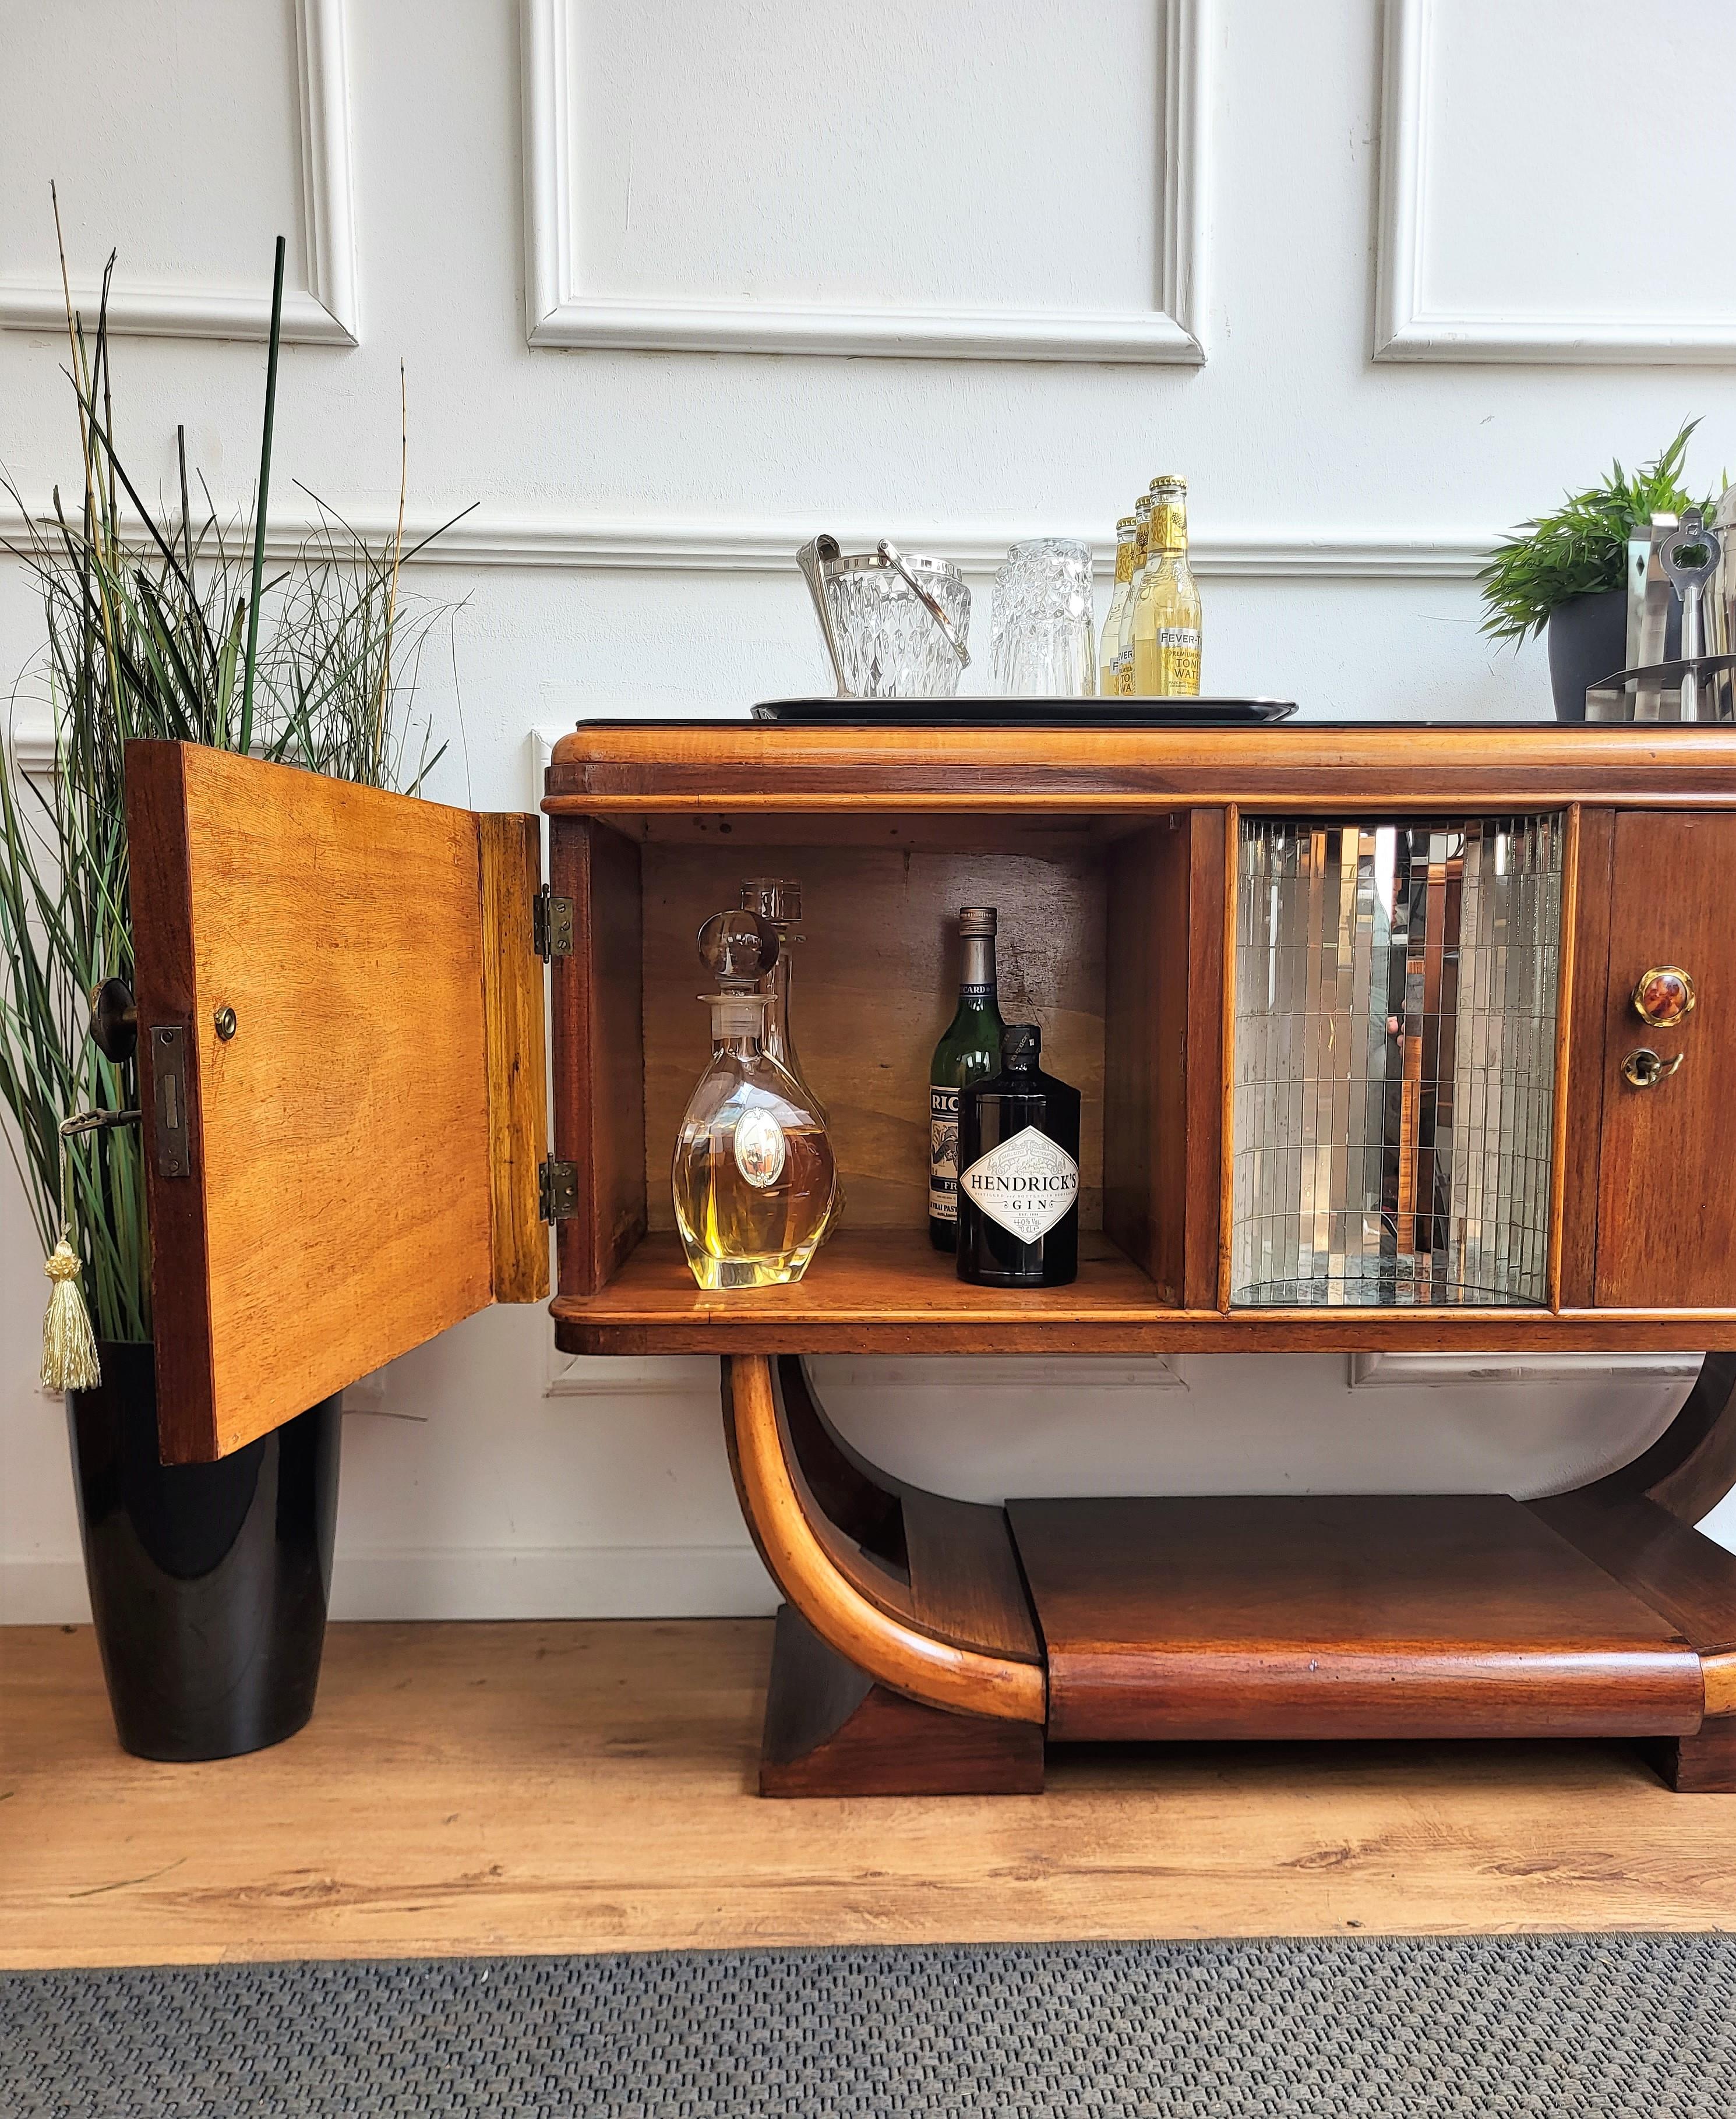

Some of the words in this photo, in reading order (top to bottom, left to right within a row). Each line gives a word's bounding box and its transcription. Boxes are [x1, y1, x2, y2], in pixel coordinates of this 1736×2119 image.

[1121, 673, 1132, 683] TO
[933, 1095, 958, 1111] RIC
[972, 1174, 1076, 1191] HENDRICK'S
[1012, 1200, 1046, 1210] GIN
